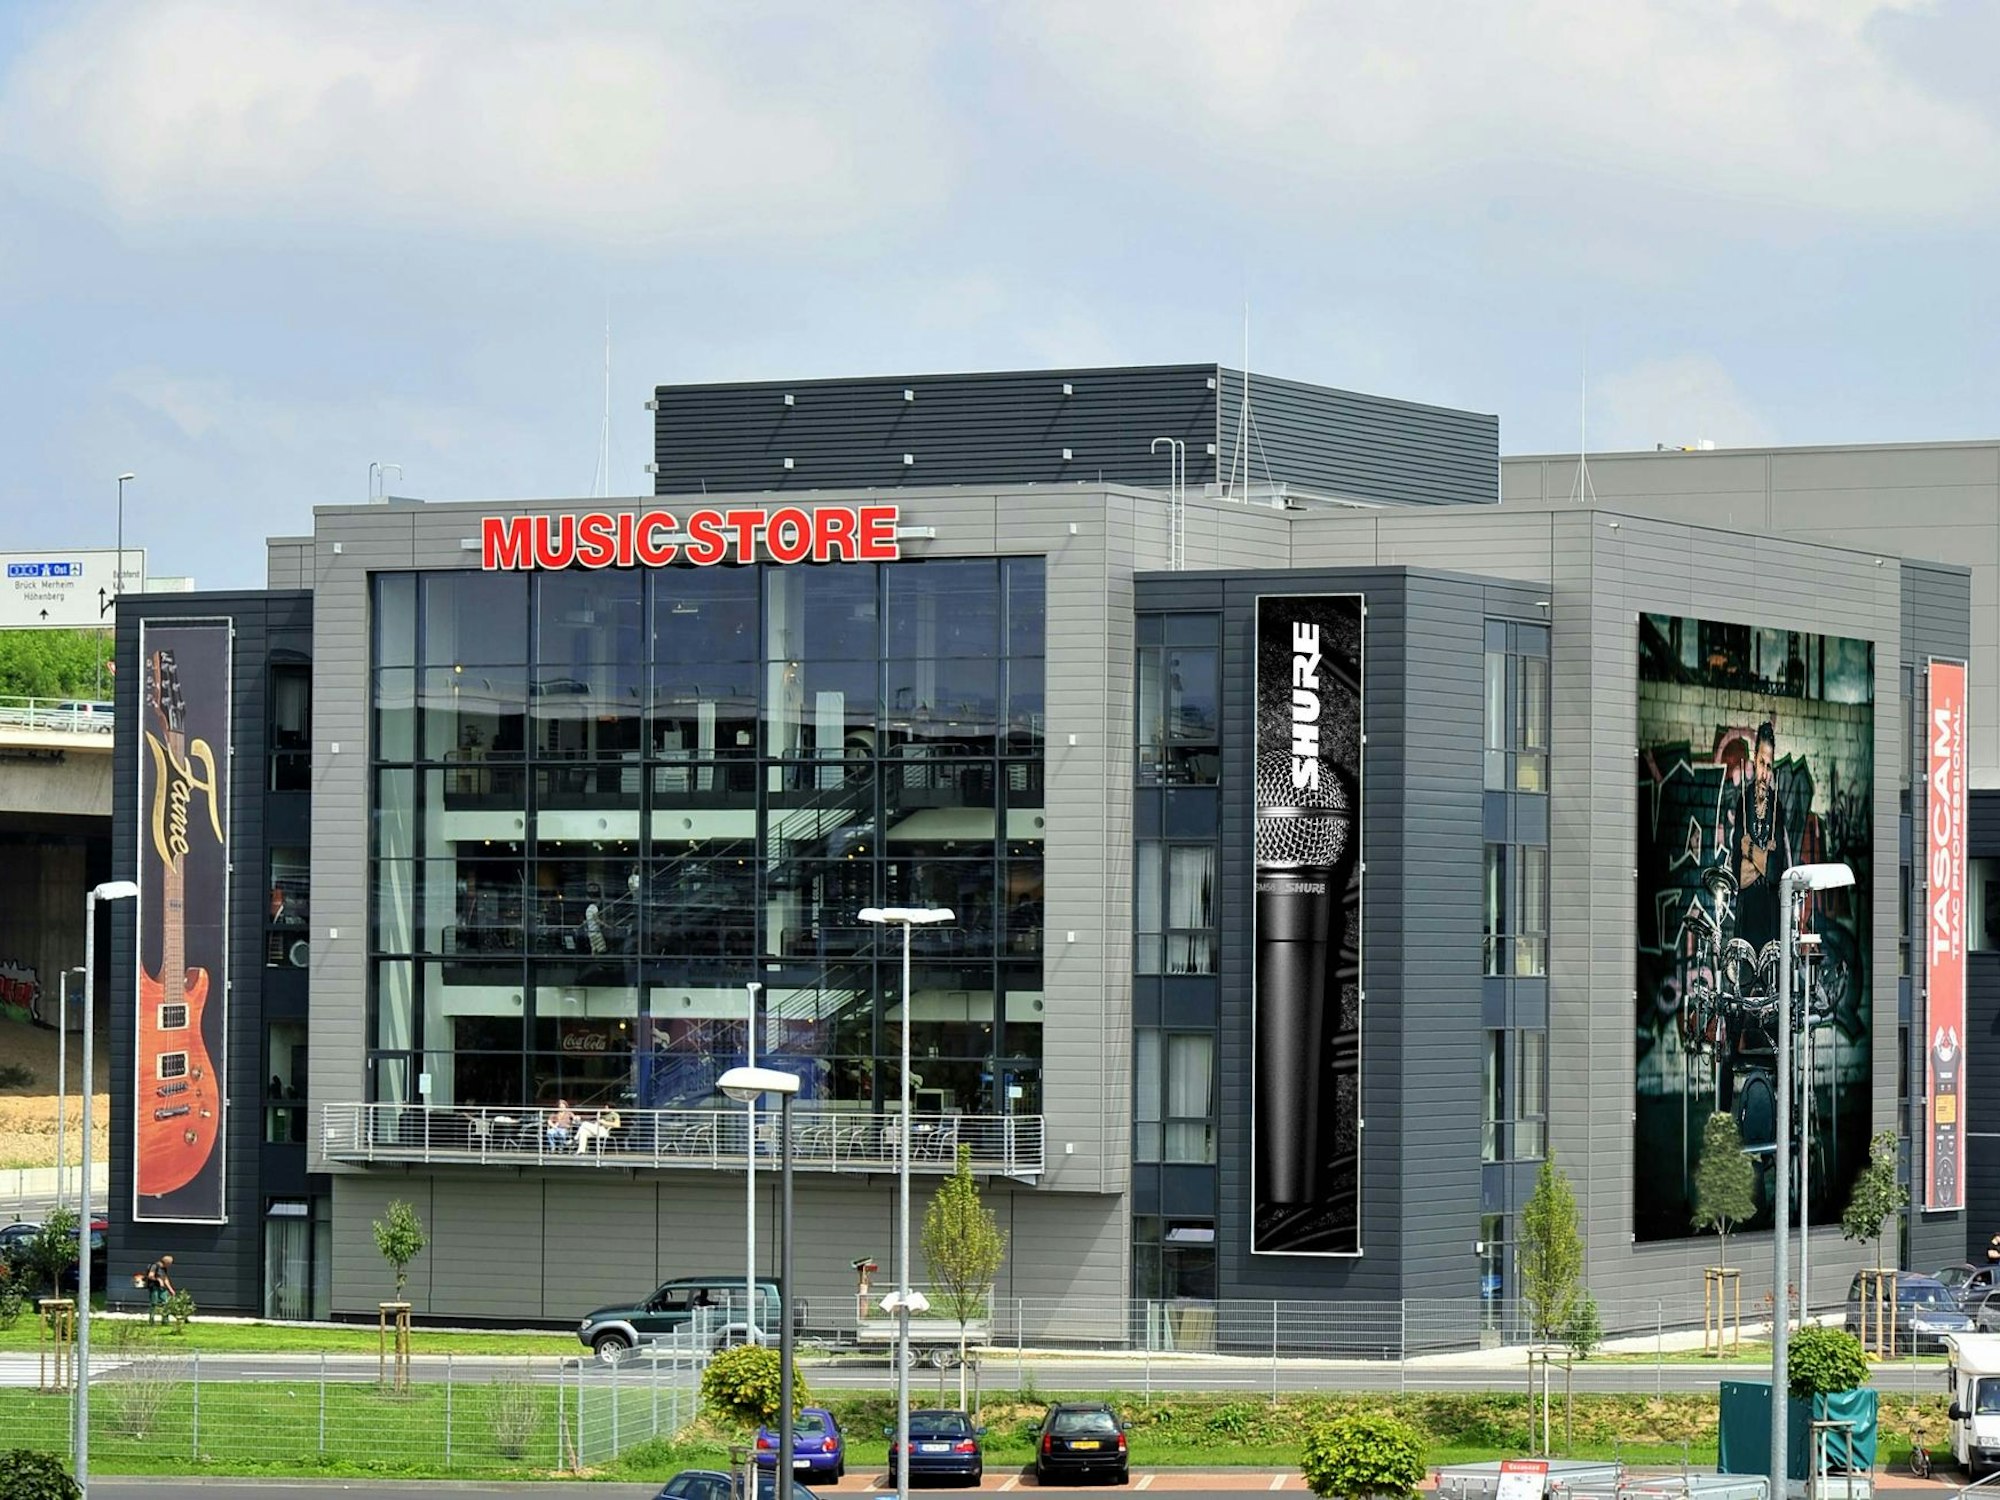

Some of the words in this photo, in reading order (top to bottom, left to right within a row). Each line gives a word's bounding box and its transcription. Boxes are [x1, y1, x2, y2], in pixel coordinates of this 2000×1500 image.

[54, 565, 68, 574] Ost
[482, 511, 679, 570] MUSIC
[686, 505, 899, 565] STORE
[15, 581, 36, 590] Brück
[42, 581, 74, 589] Merheim
[24, 592, 65, 601] Höhenberg
[1292, 621, 1322, 791] SHURE
[147, 732, 223, 872] Fame
[1952, 704, 1961, 891] PROFESSIONAL
[1933, 708, 1951, 967] TASCAM
[1285, 883, 1326, 895] SHURE
[1952, 897, 1960, 960] TEAC
